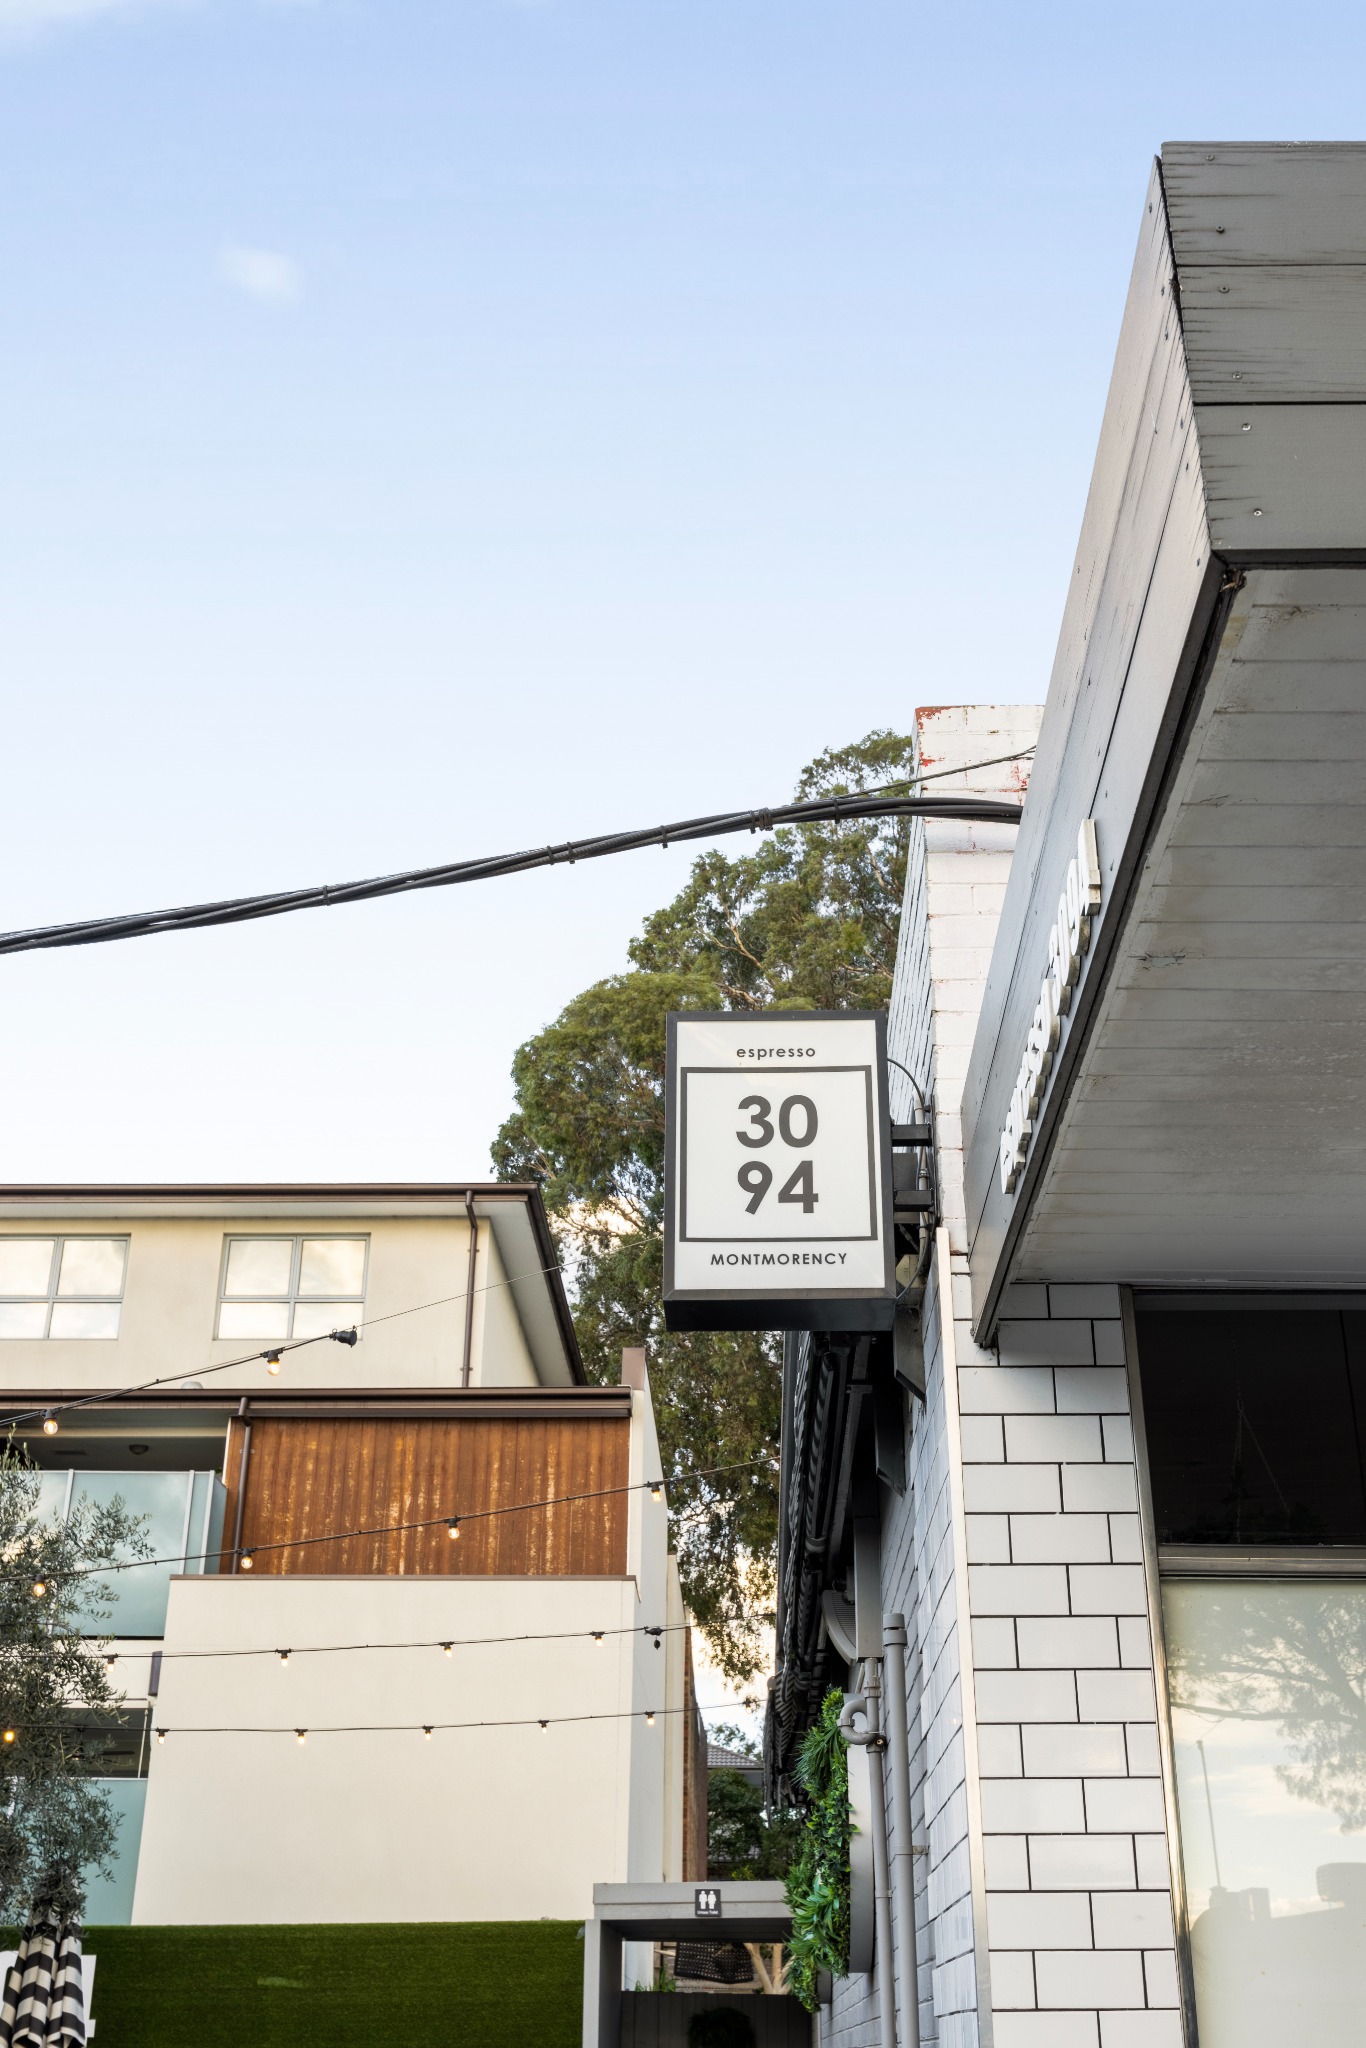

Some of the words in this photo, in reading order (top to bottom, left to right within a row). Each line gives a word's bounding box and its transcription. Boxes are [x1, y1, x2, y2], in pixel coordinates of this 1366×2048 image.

[736, 1047, 816, 1060] espresso
[736, 1095, 818, 1148] 30
[737, 1160, 819, 1215] 94
[710, 1252, 847, 1265] MONTMORENCY
